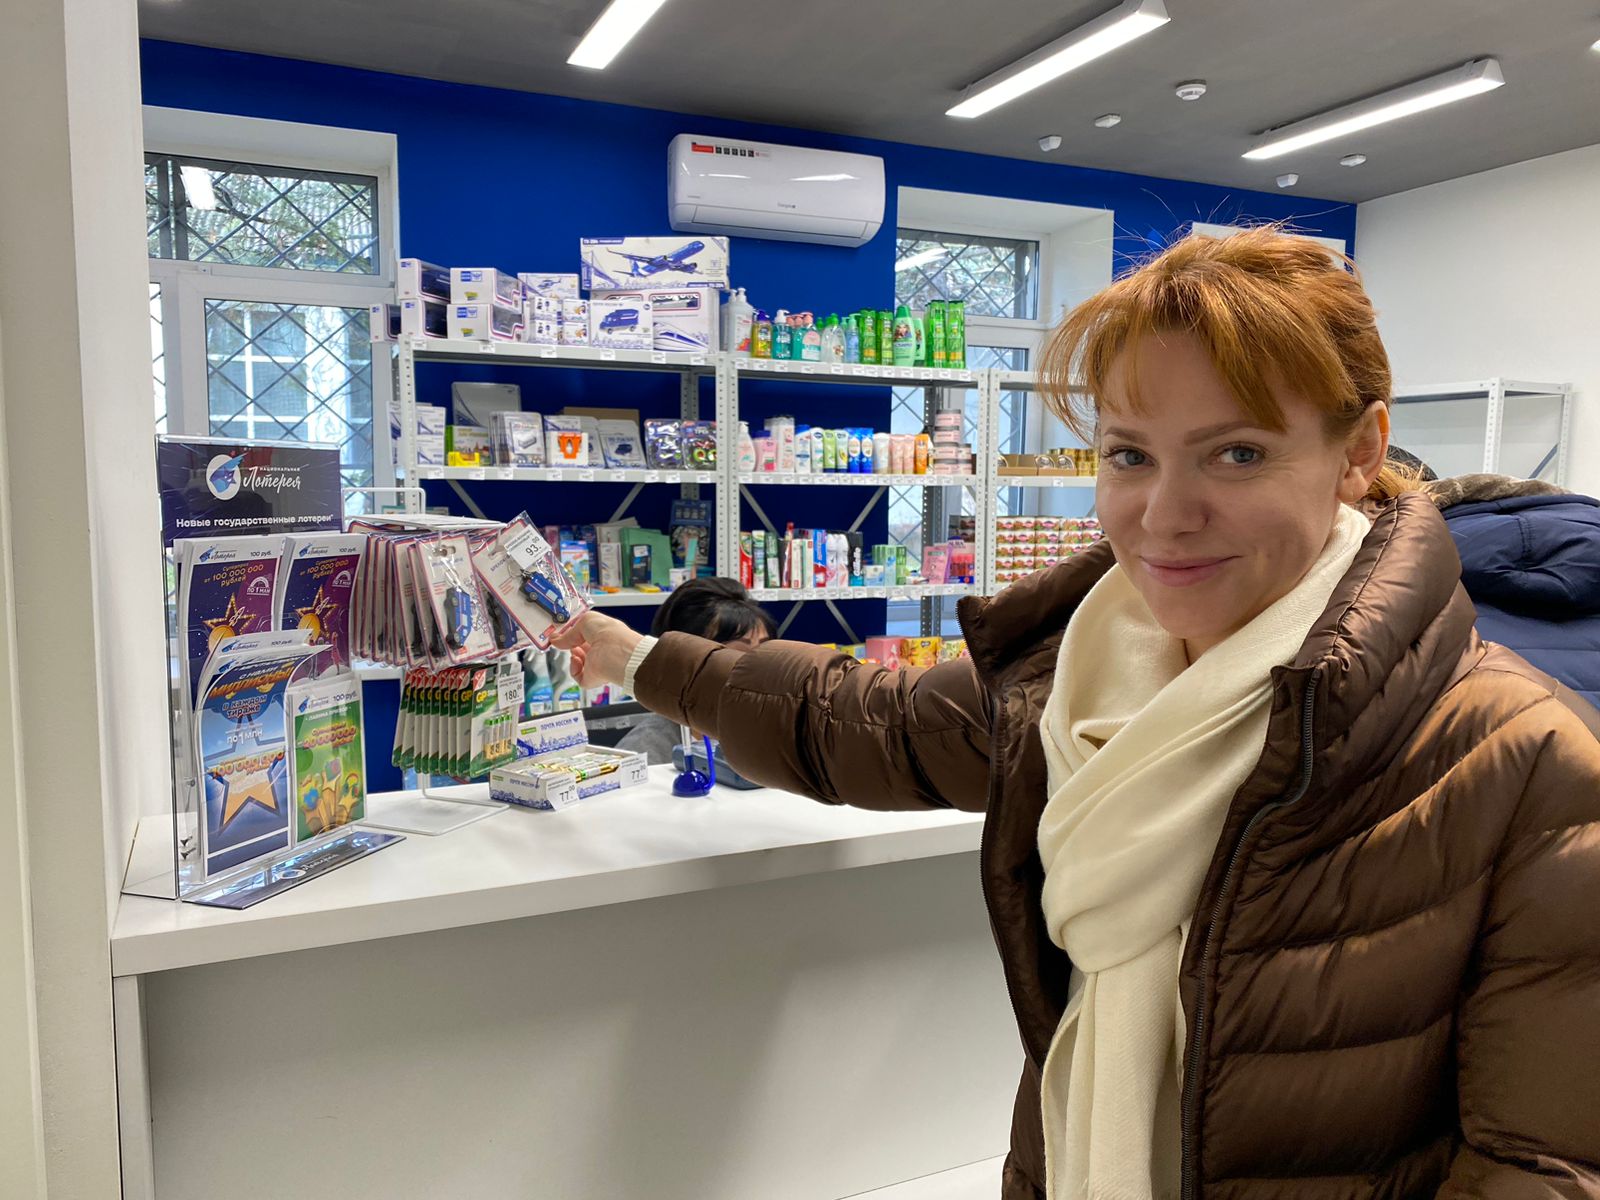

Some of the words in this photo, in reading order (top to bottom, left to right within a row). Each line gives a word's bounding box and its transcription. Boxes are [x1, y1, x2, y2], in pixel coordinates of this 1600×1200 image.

[243, 466, 301, 494] Лотерея
[176, 518, 211, 528] Новые
[213, 515, 296, 528] государственные
[213, 572, 227, 581] 100
[229, 568, 246, 577] 000
[247, 564, 264, 573] 000
[476, 690, 488, 703] GP
